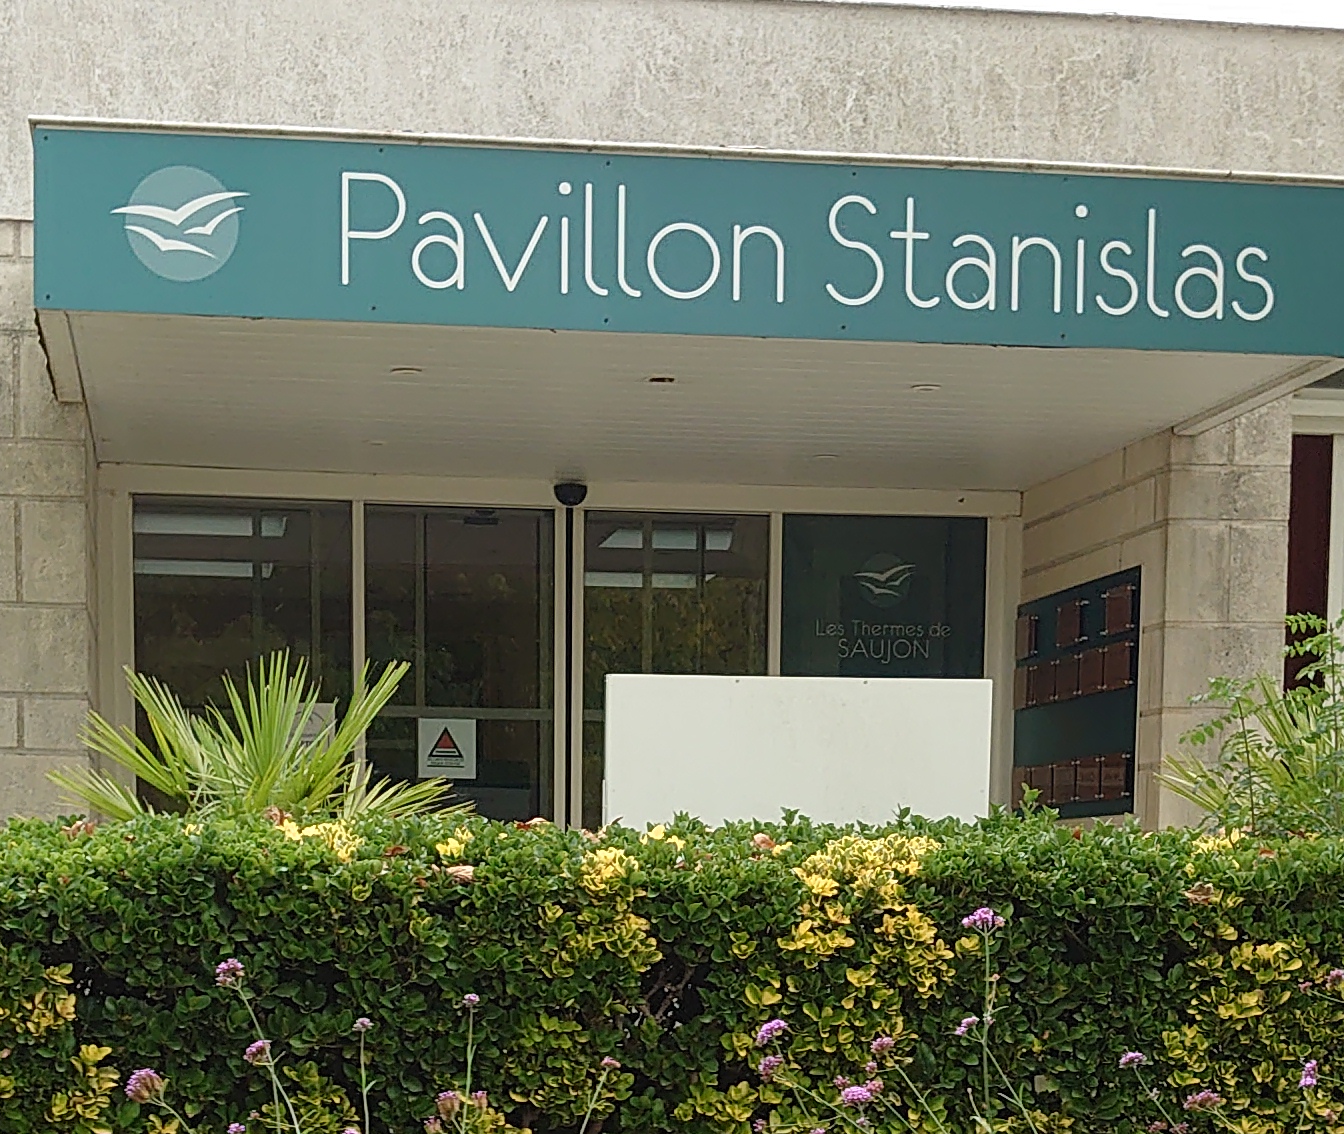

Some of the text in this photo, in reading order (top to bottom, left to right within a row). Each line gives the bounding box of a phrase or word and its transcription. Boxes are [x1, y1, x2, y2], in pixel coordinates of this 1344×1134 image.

[341, 172, 1274, 321] Pavillon Stanislas
[815, 618, 952, 638] Les Thermes de
[838, 638, 930, 664] SAUJON
